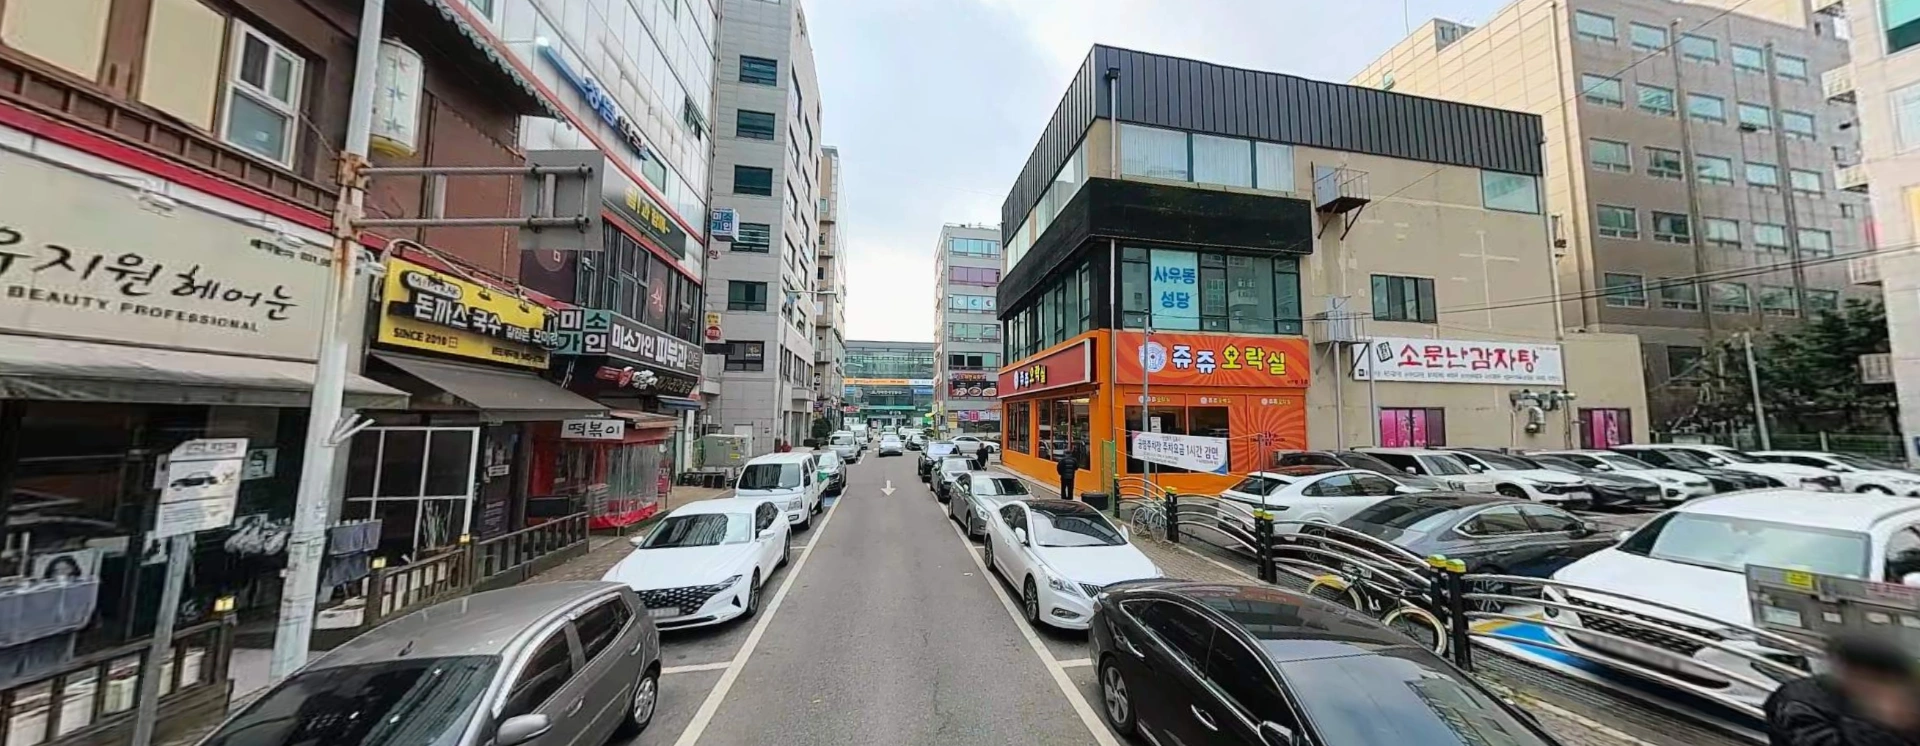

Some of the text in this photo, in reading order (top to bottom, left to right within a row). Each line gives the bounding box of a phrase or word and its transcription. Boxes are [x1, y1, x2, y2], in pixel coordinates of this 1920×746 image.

[1152, 265, 1197, 284] 사우동
[170, 263, 299, 322] 헤어눈
[1160, 290, 1191, 310] 성당
[6, 284, 260, 332] BEAUTY PROFESSIONAL
[414, 293, 470, 328] 돈까스
[472, 306, 502, 335] 국수
[560, 310, 608, 330] 미소
[393, 327, 424, 341] SINCE
[557, 332, 608, 353] 가인
[611, 323, 655, 358] 미소가인
[655, 336, 688, 370] 피부과
[568, 421, 620, 438] 떡볶이
[1137, 438, 1219, 460] 공영주차장 주차요금 1시간 감면
